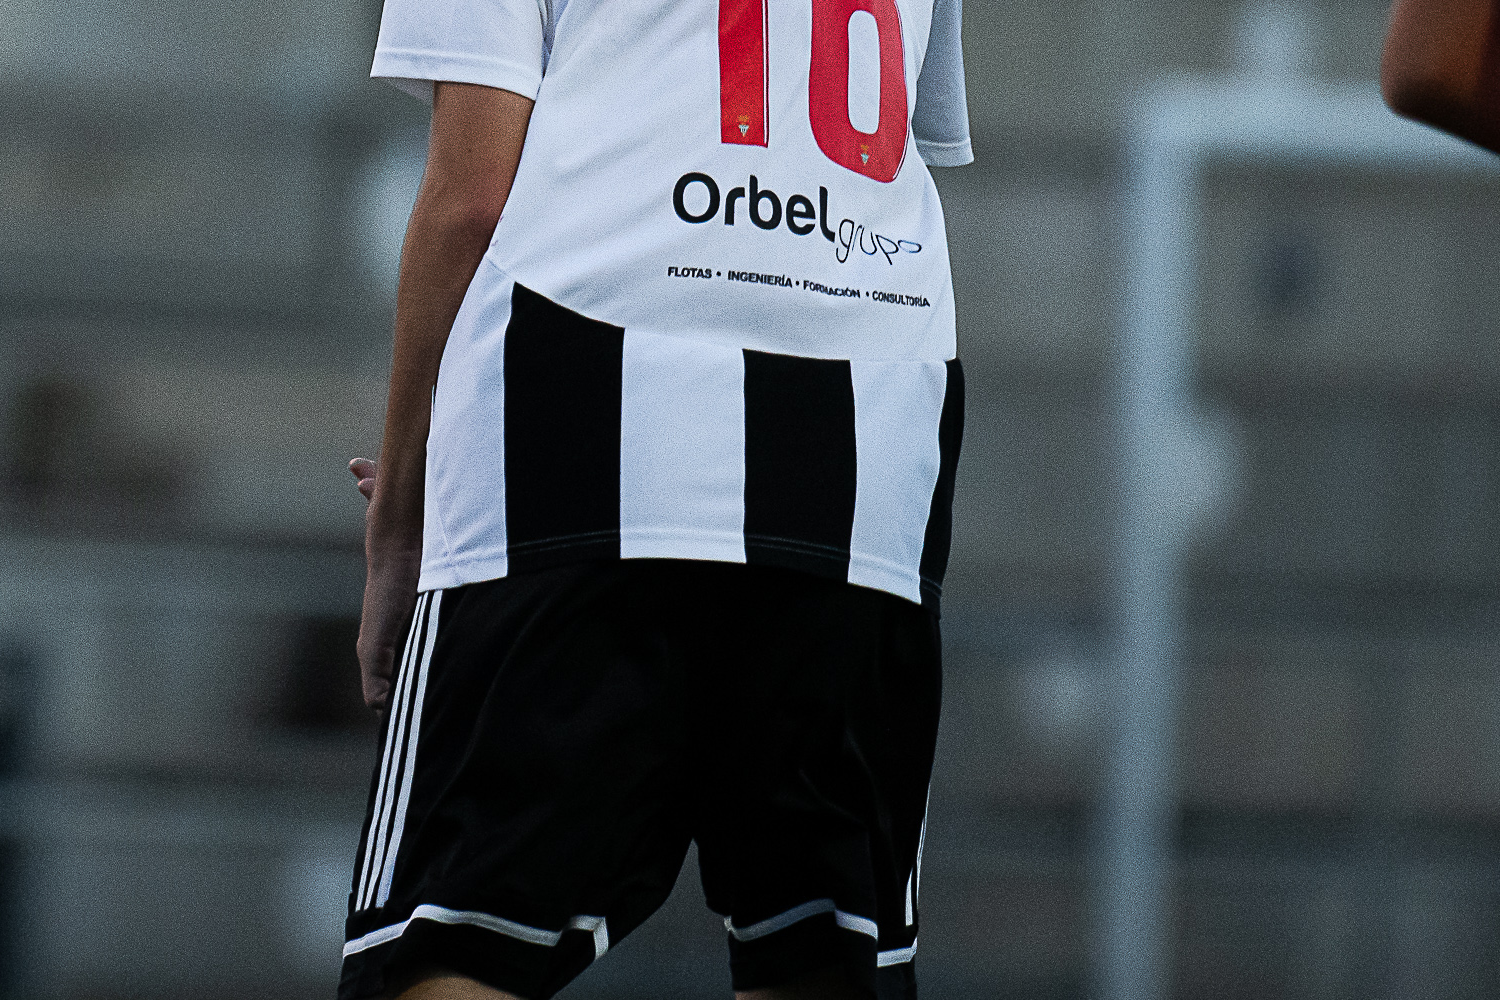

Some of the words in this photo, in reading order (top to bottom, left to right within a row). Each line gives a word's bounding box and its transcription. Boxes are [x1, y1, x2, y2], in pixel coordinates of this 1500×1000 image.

[667, 266, 712, 279] FLOTAS
[727, 270, 793, 289] INGENIERÍA
[872, 290, 931, 308] CONSULTORÍA
